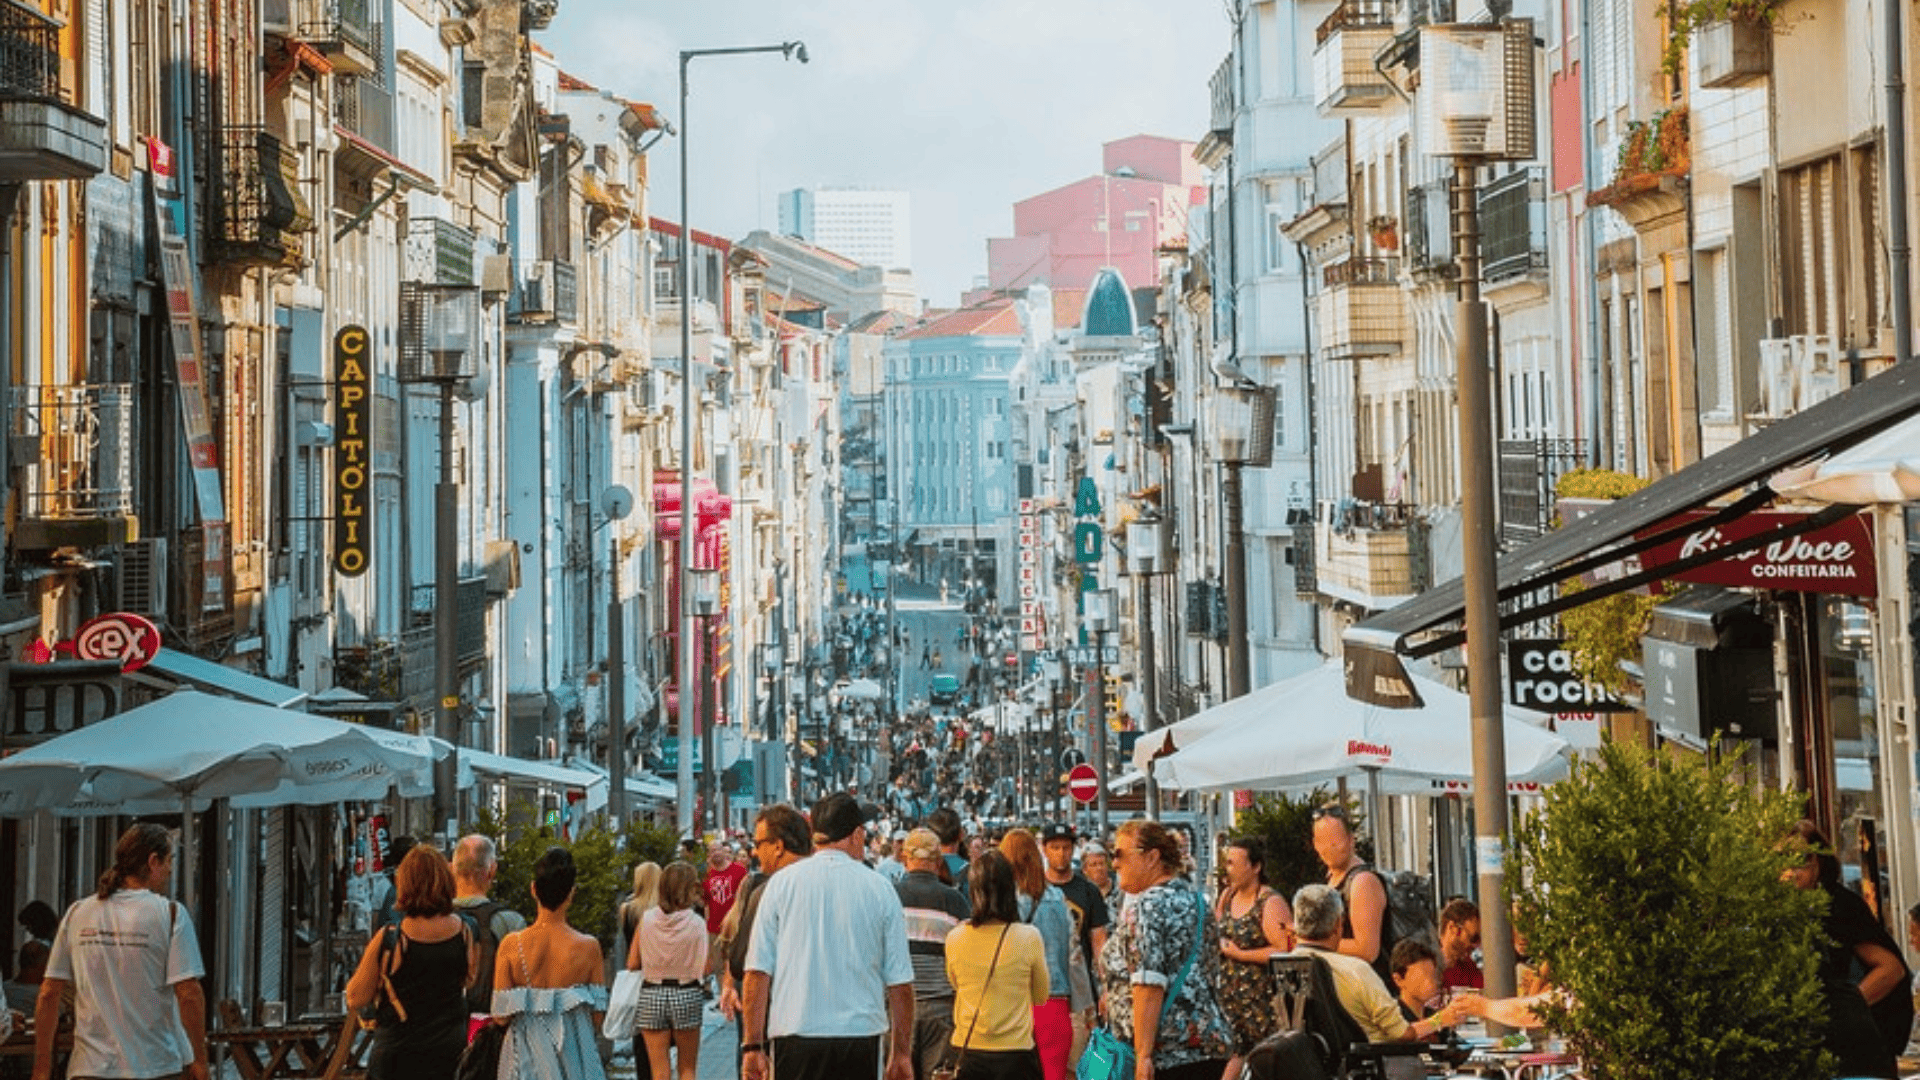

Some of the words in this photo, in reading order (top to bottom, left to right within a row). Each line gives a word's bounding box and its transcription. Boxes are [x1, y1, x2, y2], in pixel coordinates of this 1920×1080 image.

[340, 331, 365, 571] CAPITÓLIO
[1021, 500, 1033, 632] PERFECTA
[1751, 564, 1857, 578] CONFEITARIA
[1515, 675, 1620, 705] roch
